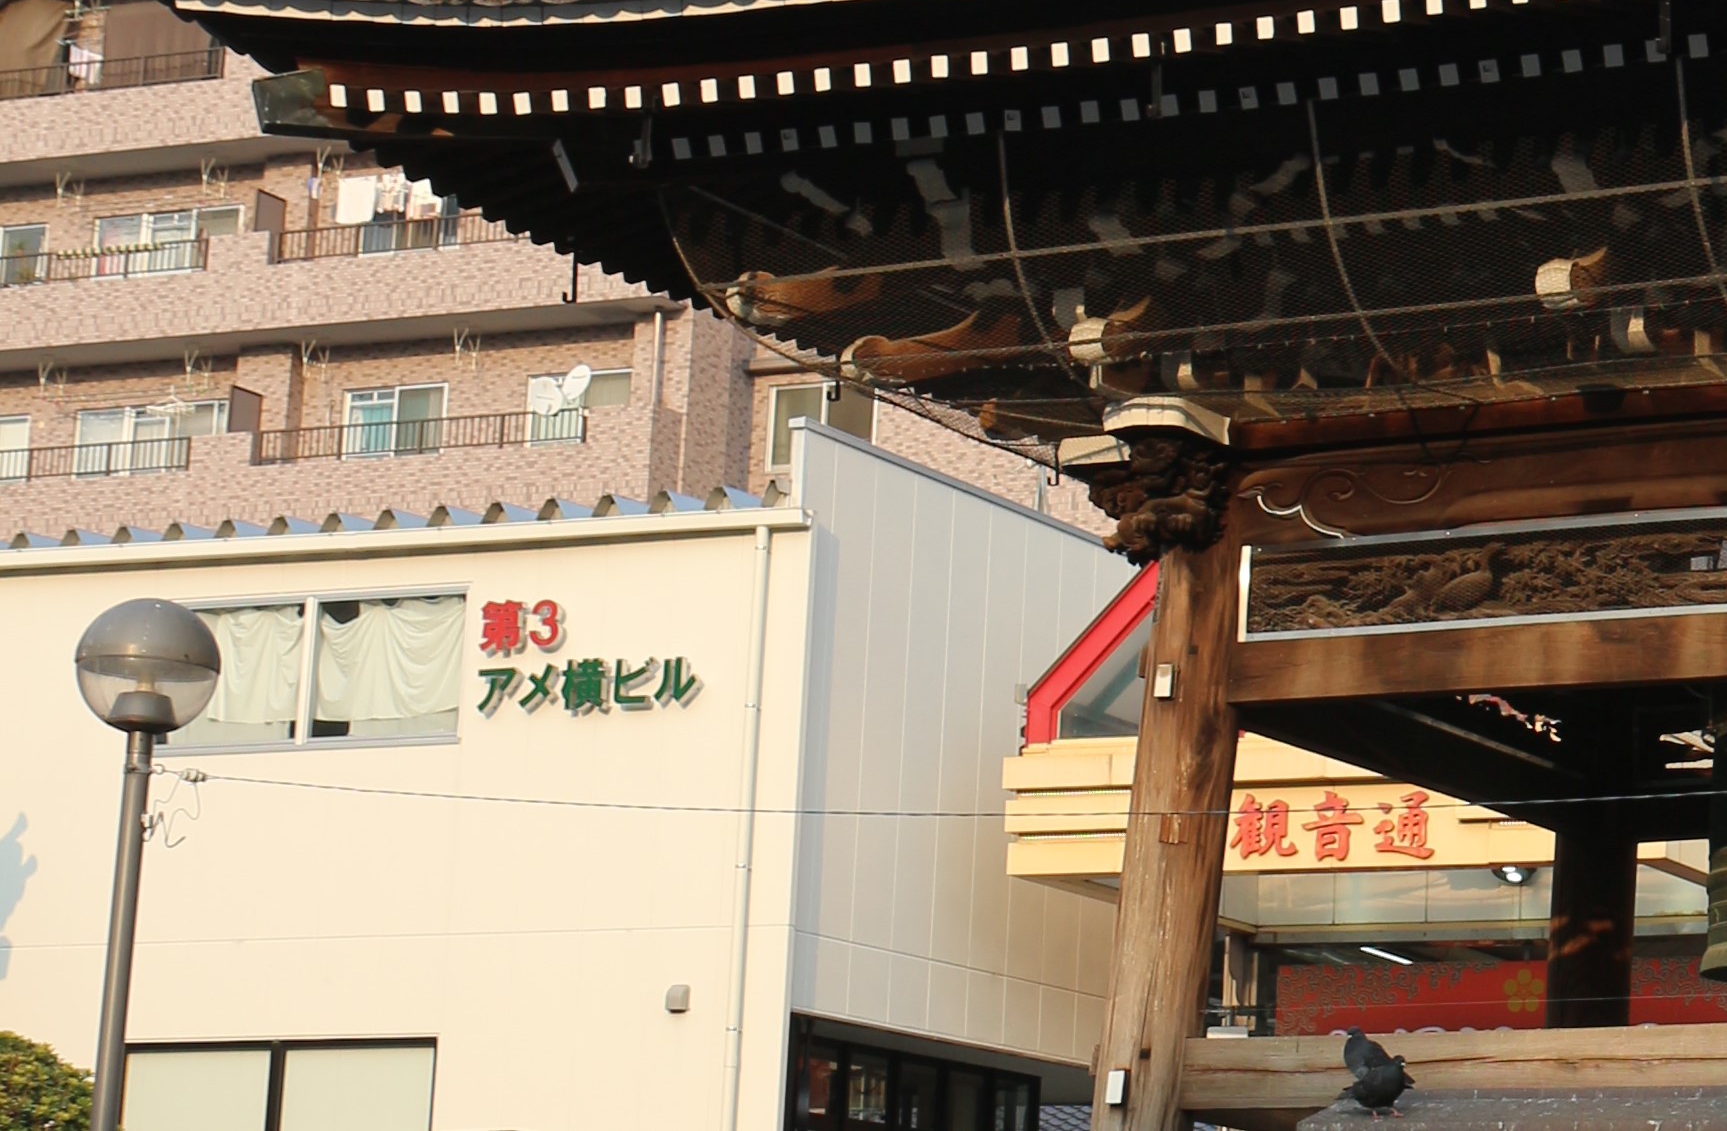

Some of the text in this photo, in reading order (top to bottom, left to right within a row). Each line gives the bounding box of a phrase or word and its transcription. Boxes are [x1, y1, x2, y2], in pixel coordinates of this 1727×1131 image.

[479, 599, 562, 654] 第3
[477, 656, 701, 715] アメ横ビル
[1230, 790, 1435, 861] 観音通
